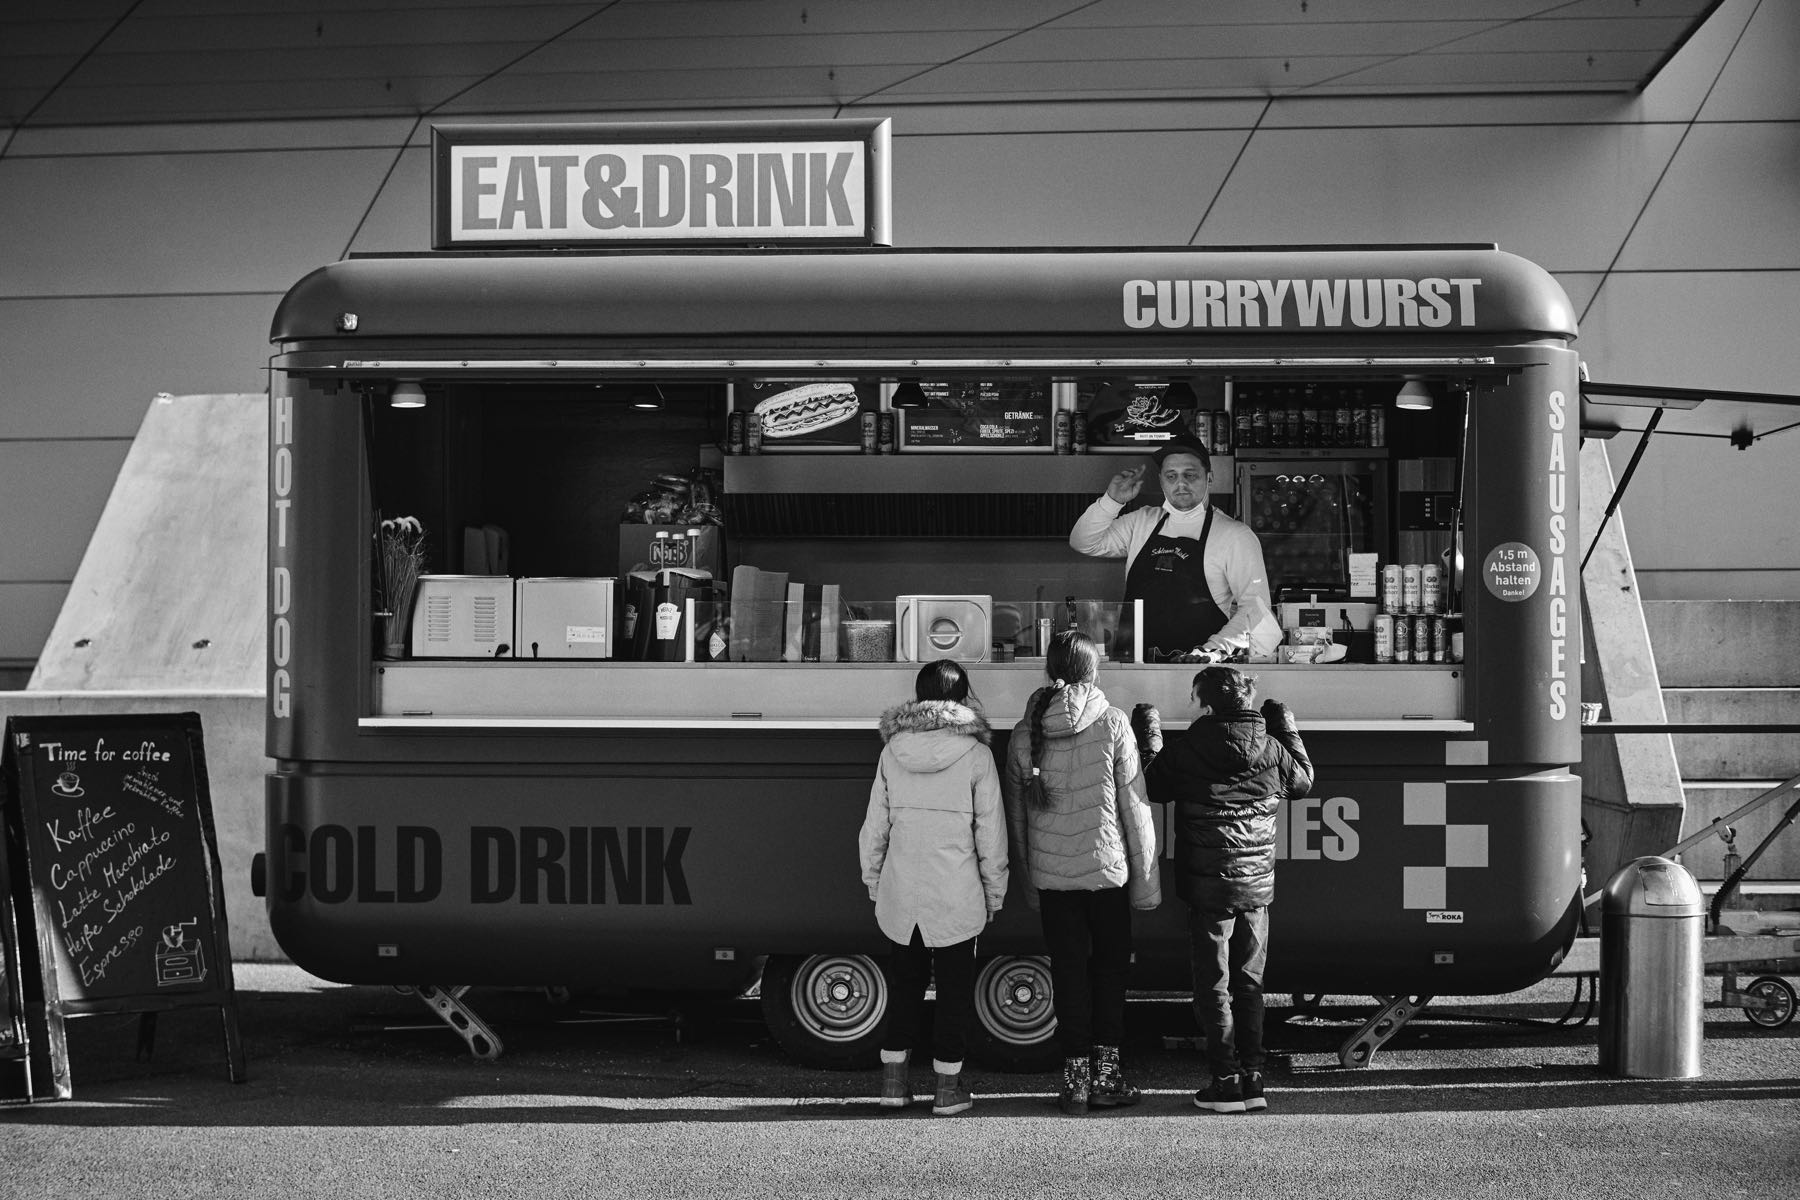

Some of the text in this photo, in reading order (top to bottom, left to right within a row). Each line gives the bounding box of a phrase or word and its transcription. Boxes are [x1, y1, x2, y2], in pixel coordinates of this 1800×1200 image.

[462, 152, 855, 231] EAT&DRINK
[1123, 278, 1482, 329] CURRYWURST
[1004, 410, 1033, 420] GETRÄNKE
[273, 397, 293, 718] HOT DOG
[1490, 562, 1536, 572] Abstand
[1495, 575, 1531, 585] halten
[1498, 550, 1528, 560] 1,5 m
[1549, 390, 1566, 721] SAUSAGES
[39, 738, 171, 761] Time for coffee
[46, 806, 117, 852] Kaffee
[51, 822, 135, 890] Cappuccino
[58, 826, 170, 929] Latte Macchiato
[278, 823, 694, 906] COLD DRINK
[64, 854, 177, 957] Heiße Schokolade
[79, 925, 144, 987] Espresso
